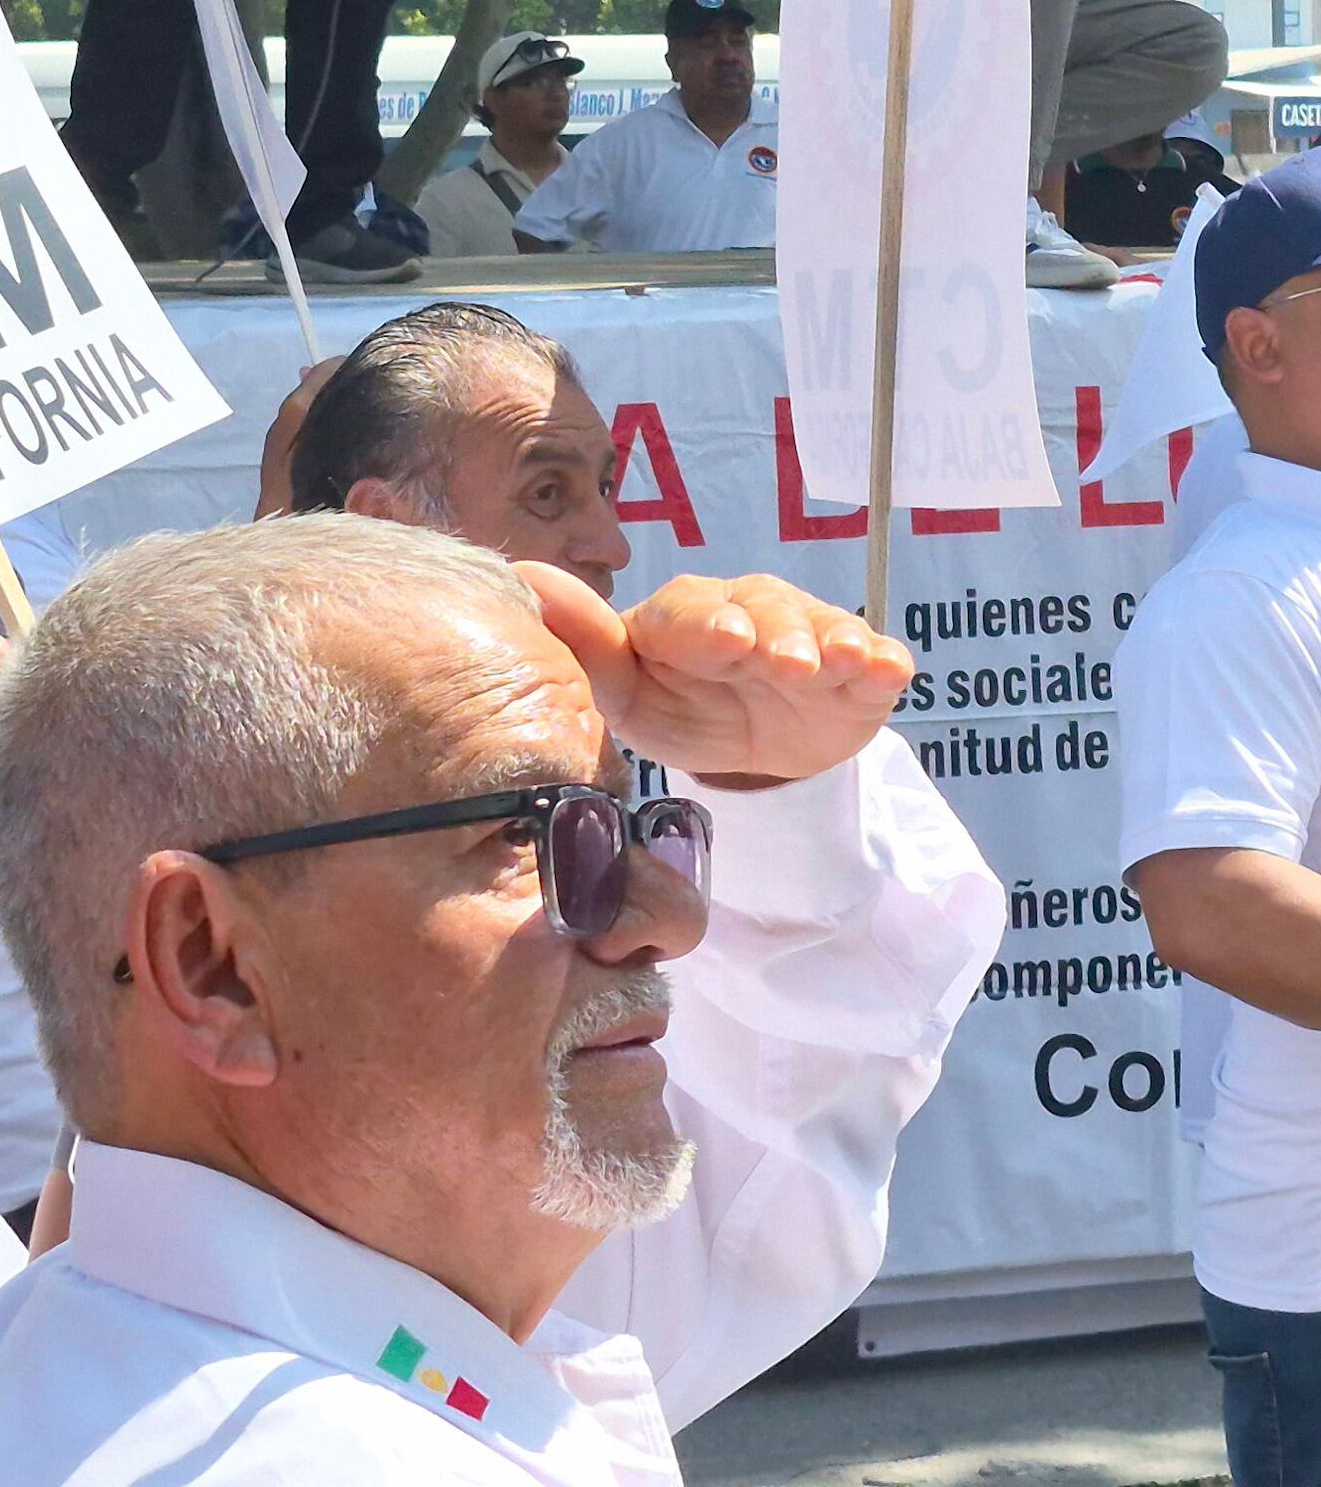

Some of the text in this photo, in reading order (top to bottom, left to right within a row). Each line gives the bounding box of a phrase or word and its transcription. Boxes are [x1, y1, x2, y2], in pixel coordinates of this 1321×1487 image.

[1075, 385, 1194, 529] L
[905, 588, 1092, 652] quienes
[1113, 591, 1147, 631] c
[946, 651, 1113, 708] sociale
[1056, 720, 1110, 771] de
[1010, 878, 1142, 930] ñeros
